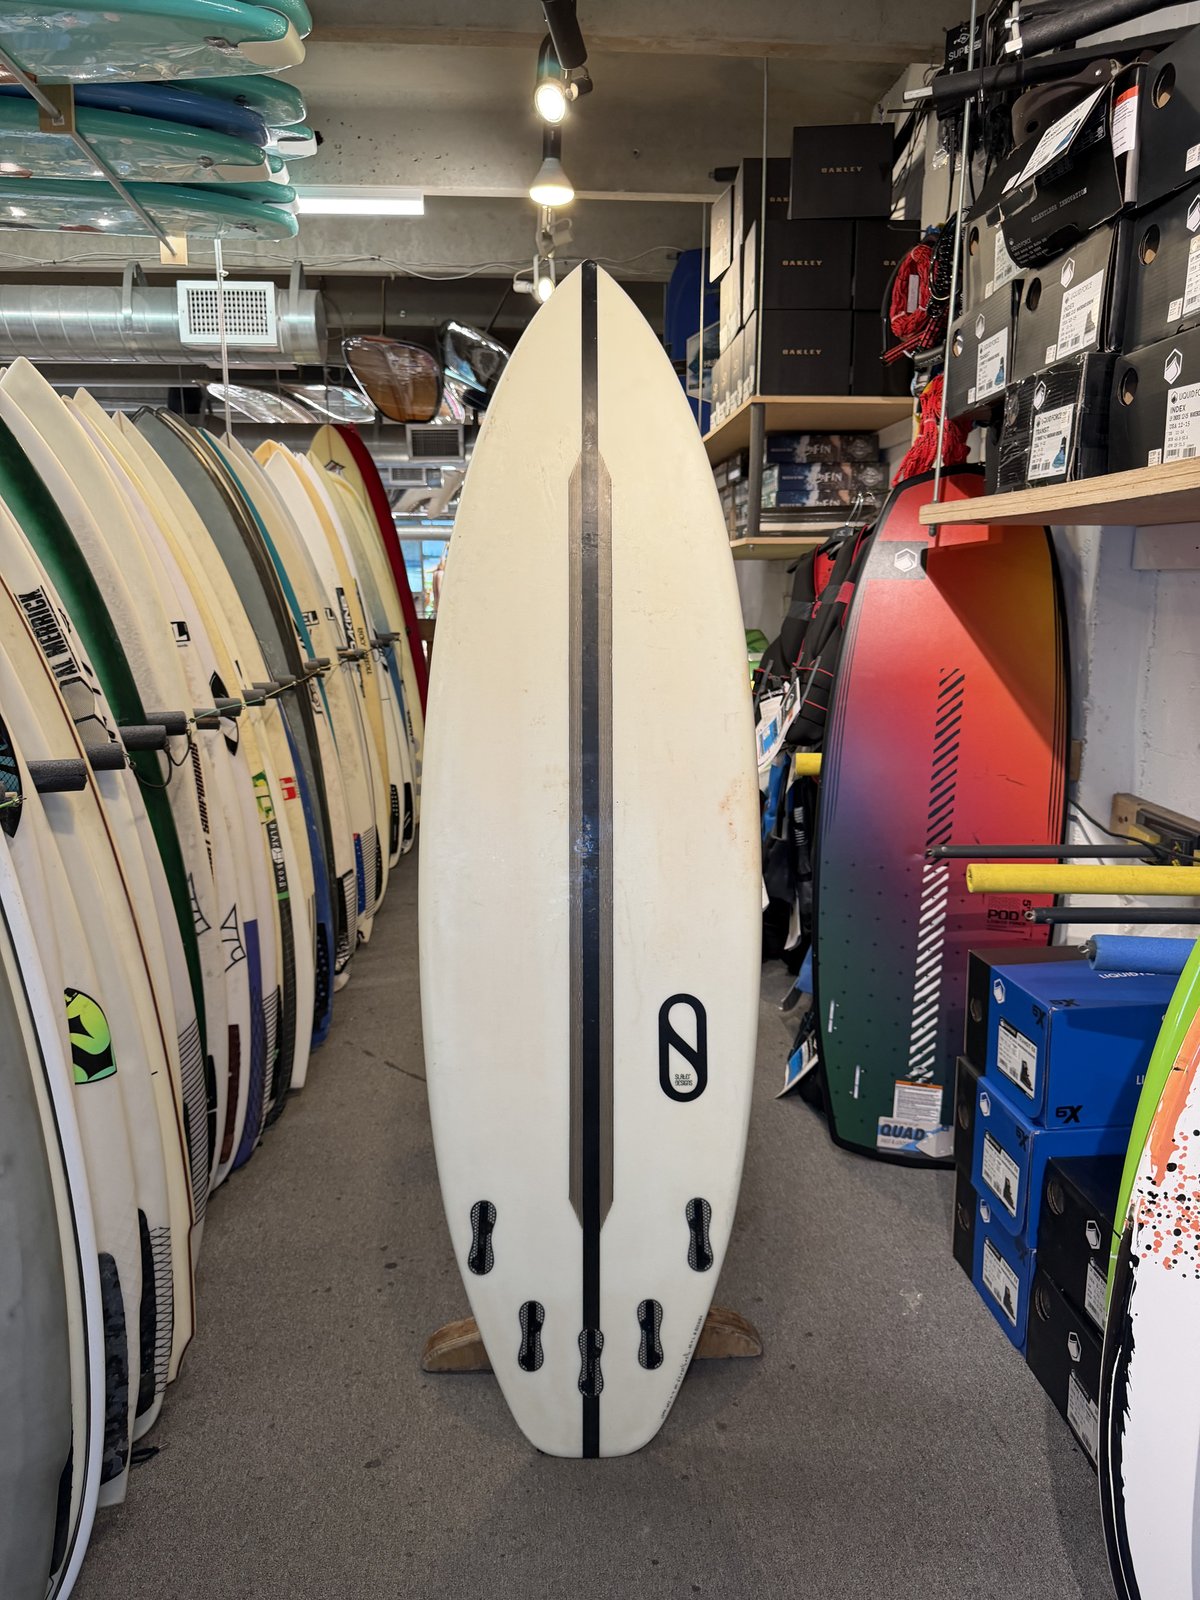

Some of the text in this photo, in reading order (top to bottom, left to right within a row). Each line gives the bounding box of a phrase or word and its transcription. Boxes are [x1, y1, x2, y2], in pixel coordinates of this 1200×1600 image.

[820, 165, 864, 174] OAKLEY
[1170, 404, 1186, 414] INDEX
[18, 588, 78, 678] AL MERRICK
[189, 742, 210, 834] SURFBOARDS
[987, 908, 1019, 921] POD
[1055, 1104, 1083, 1124] 6X
[880, 1123, 926, 1142] QUAD
